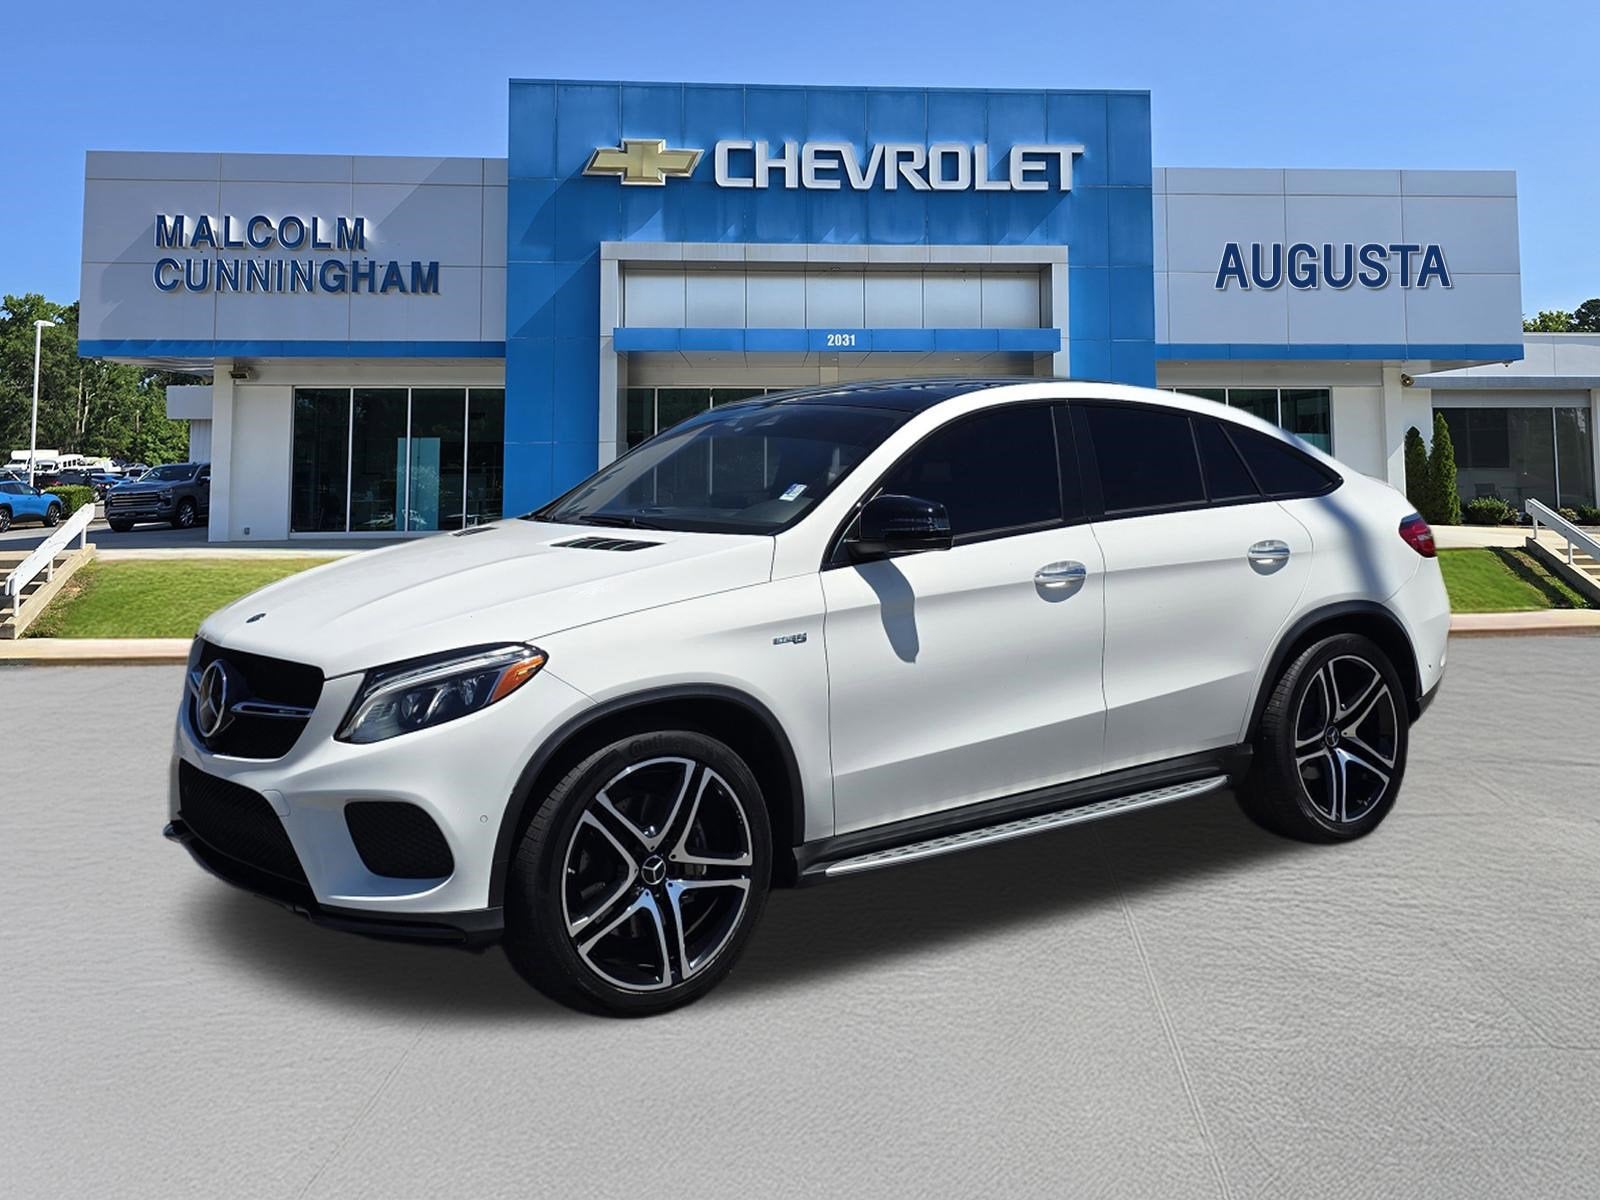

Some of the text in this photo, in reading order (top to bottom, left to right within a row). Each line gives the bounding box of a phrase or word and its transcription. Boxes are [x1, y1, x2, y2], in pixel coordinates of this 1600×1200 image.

[714, 138, 1084, 192] CHEVROLET
[157, 214, 367, 250] MALCOLM
[154, 257, 440, 294] CUNNINGHAM
[1215, 242, 1453, 290] AUGUSTA
[827, 333, 856, 346] 2031
